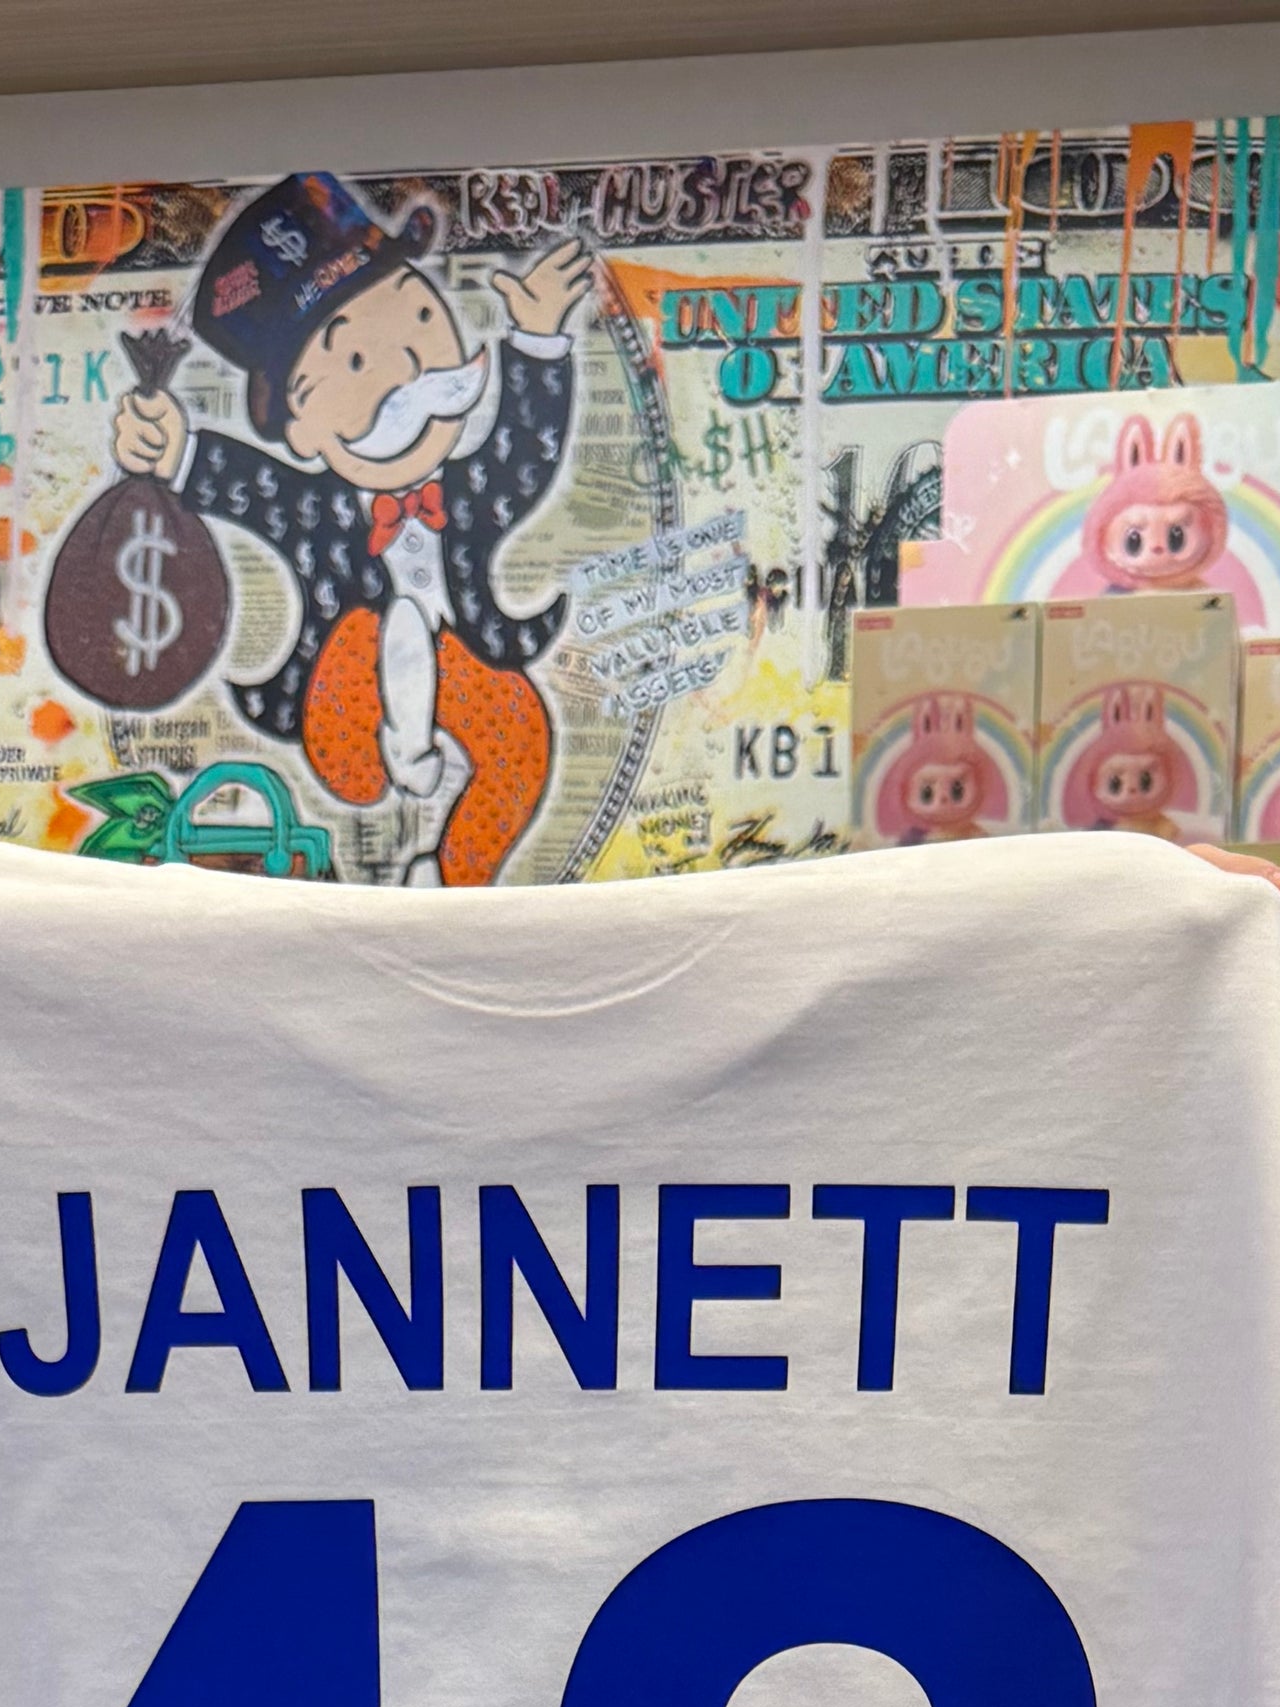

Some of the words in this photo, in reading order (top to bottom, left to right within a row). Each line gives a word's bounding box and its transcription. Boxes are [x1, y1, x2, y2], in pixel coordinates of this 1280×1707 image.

[79, 291, 173, 314] NOTE
[954, 274, 1250, 336] STATES
[820, 338, 1184, 398] AMERICA
[576, 605, 616, 635] OF
[667, 564, 745, 600] MOST
[589, 609, 741, 679] VALUABLE
